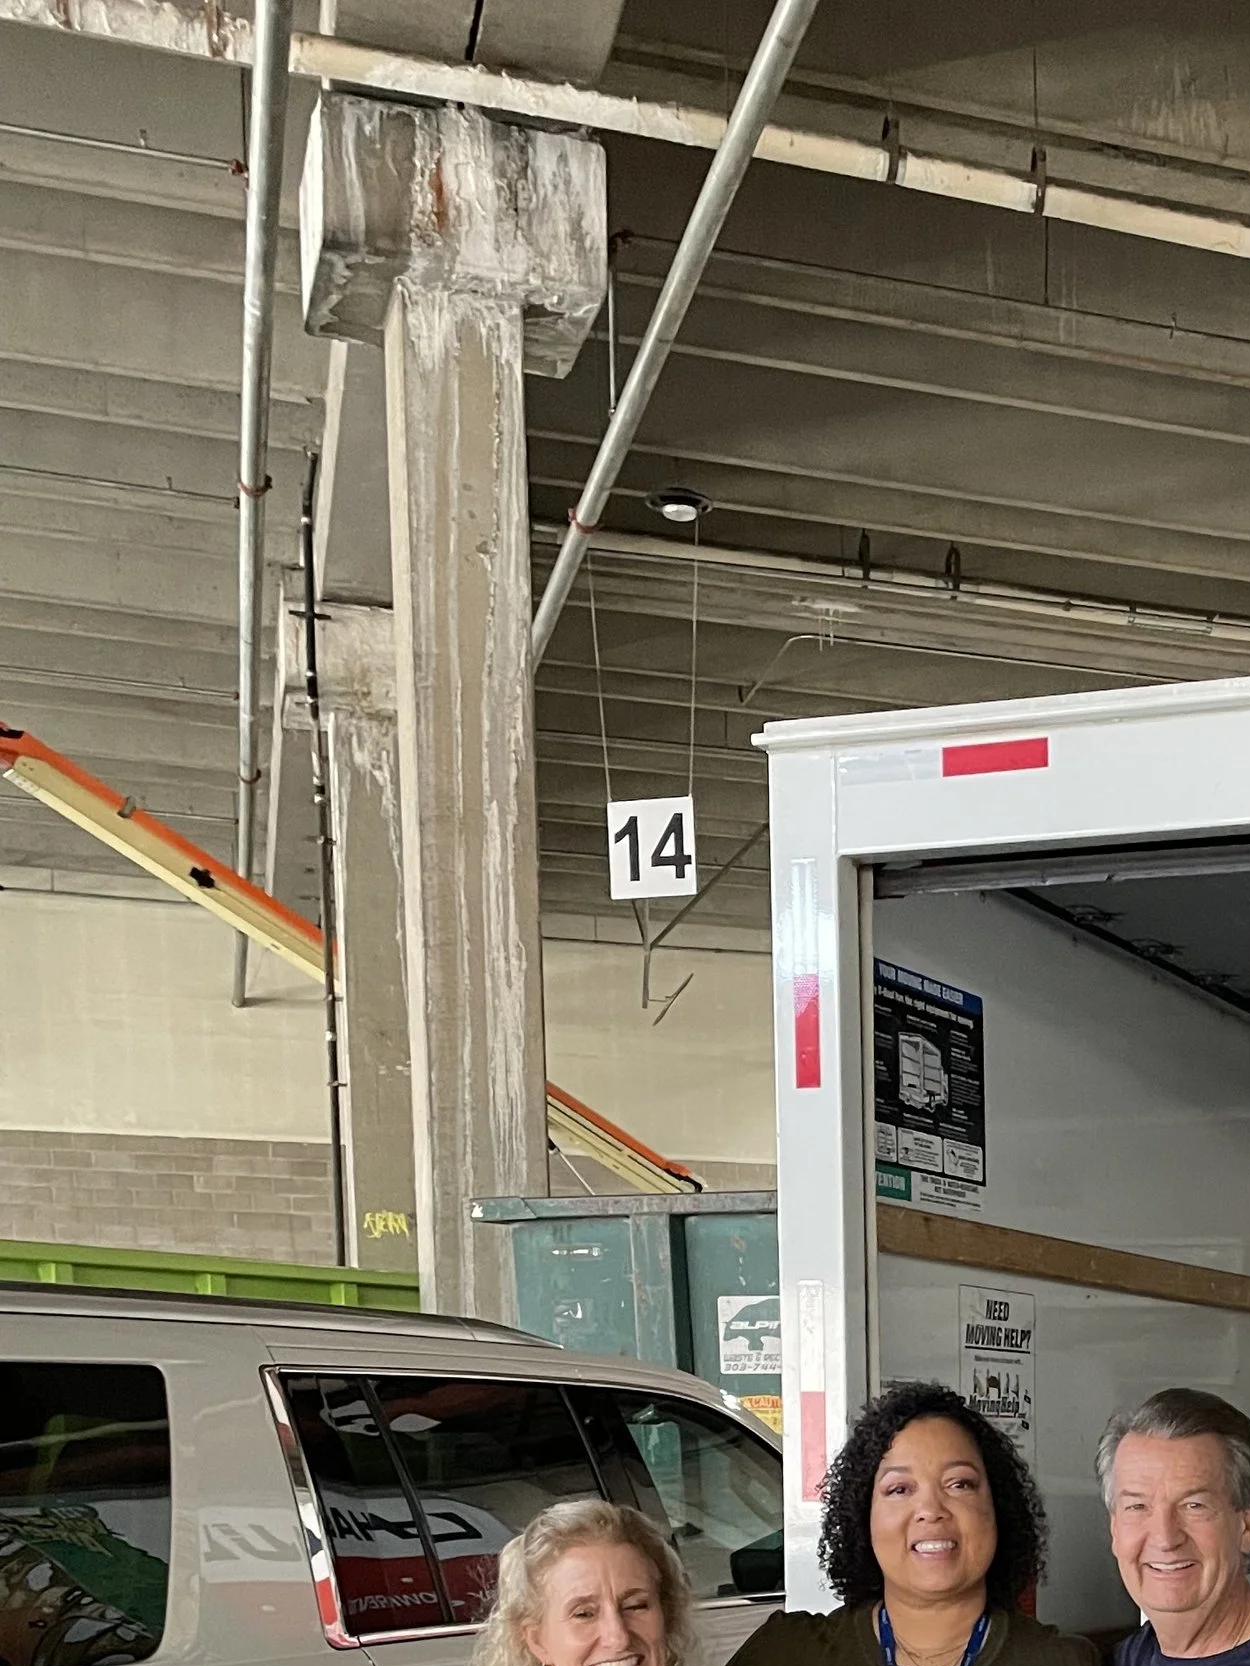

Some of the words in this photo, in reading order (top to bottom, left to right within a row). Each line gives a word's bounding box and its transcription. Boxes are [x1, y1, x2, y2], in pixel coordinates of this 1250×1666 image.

[614, 813, 692, 883] 14
[985, 1299, 1010, 1321] NEED
[965, 1323, 1002, 1347] MOVING
[1003, 1329, 1032, 1349] HELP?
[723, 1353, 753, 1362] WASTE
